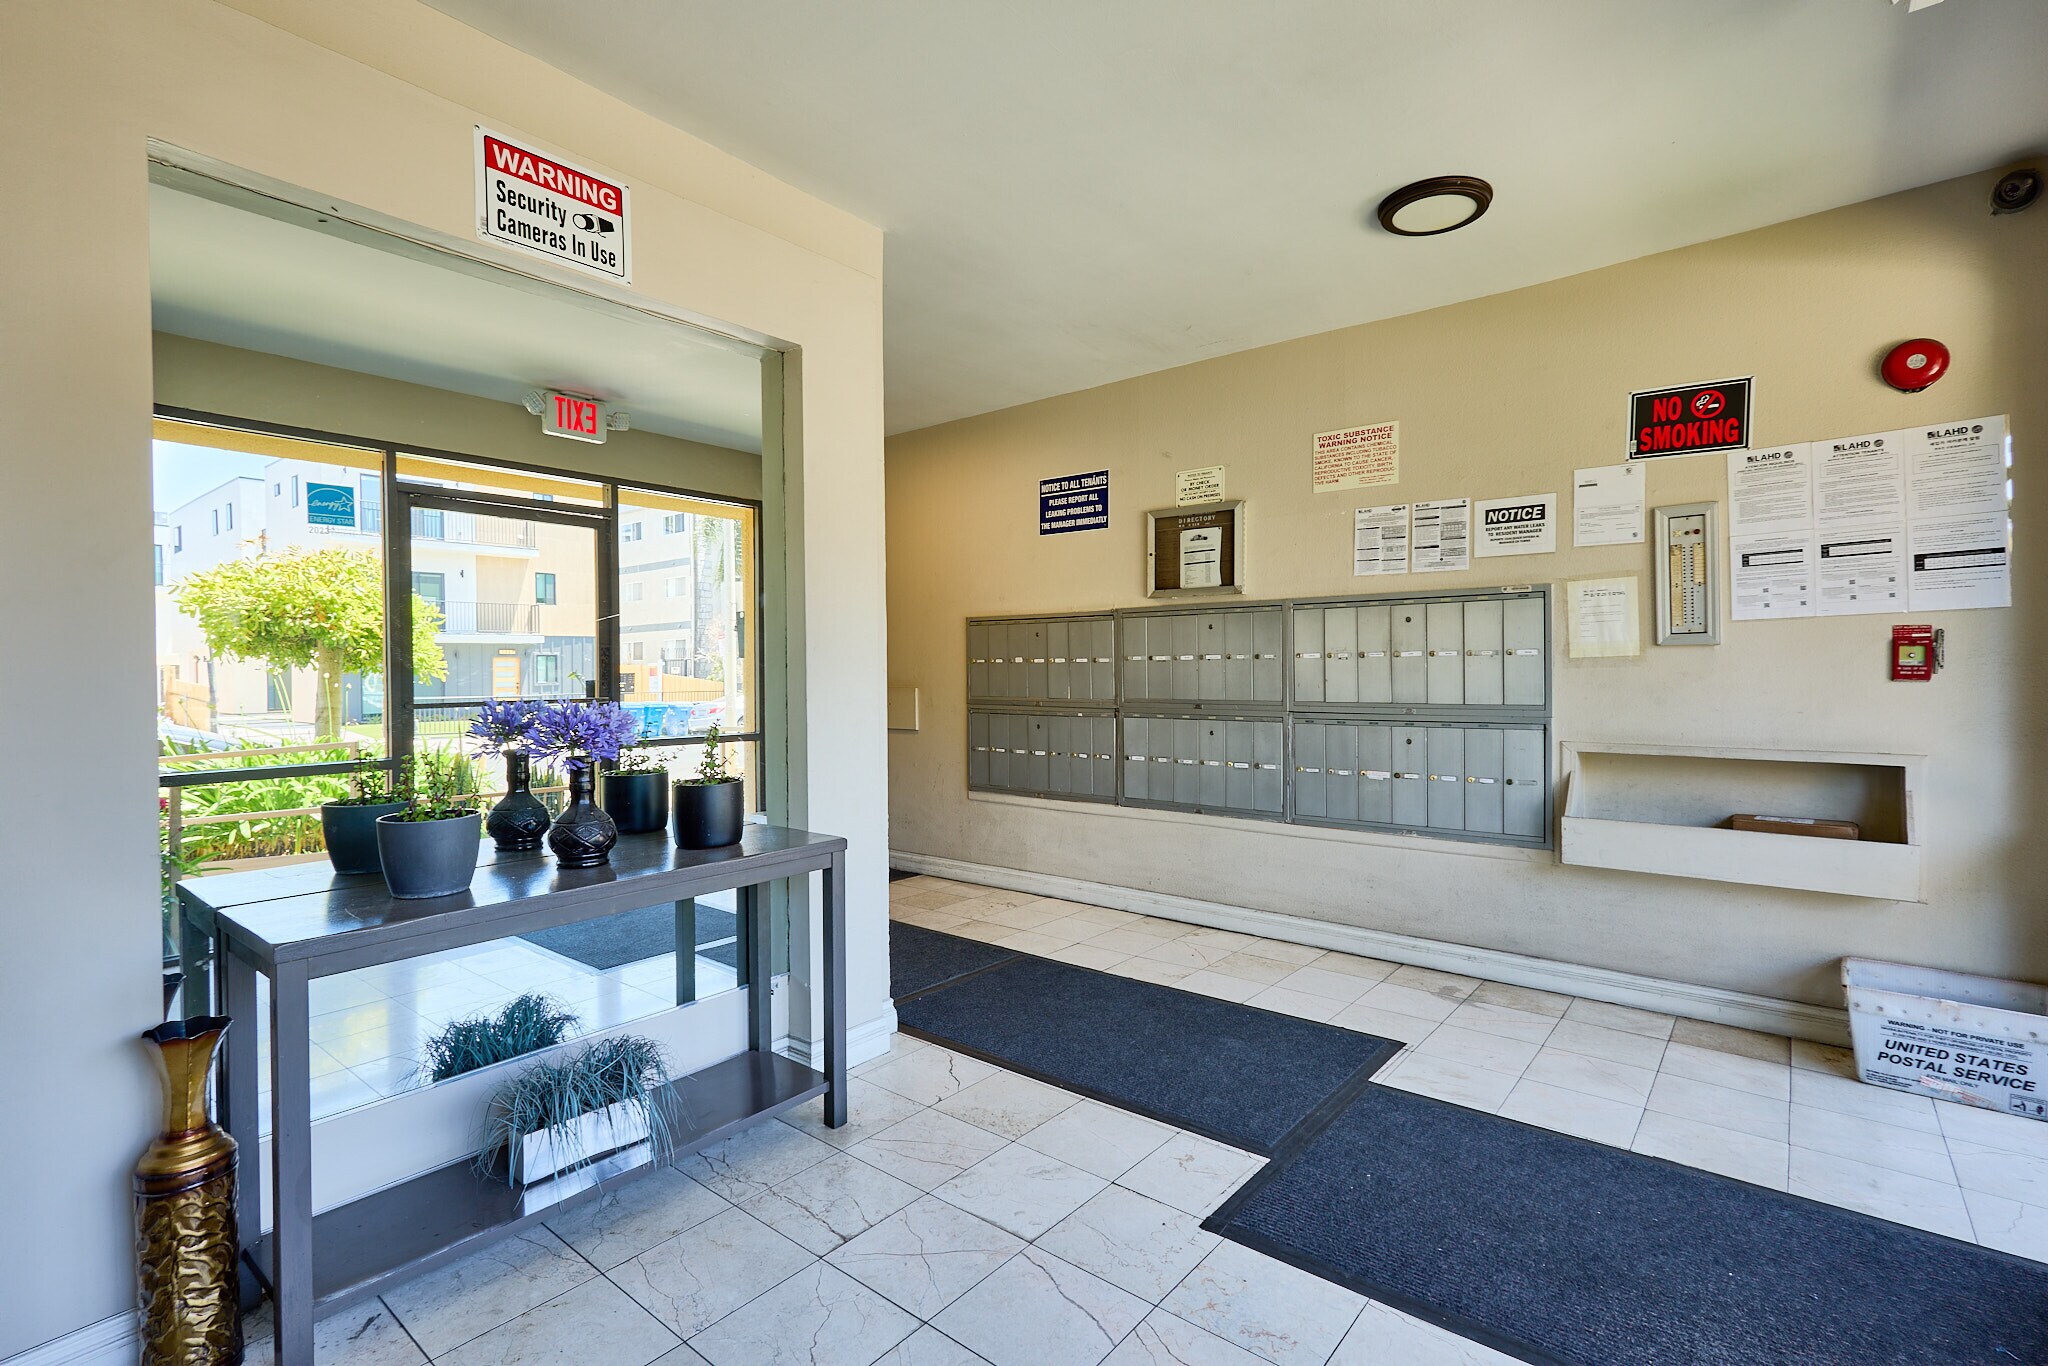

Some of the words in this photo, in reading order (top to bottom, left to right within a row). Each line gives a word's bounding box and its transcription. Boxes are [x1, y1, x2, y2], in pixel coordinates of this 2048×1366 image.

[493, 143, 617, 211] WARNING
[496, 180, 567, 228] Security
[497, 208, 567, 251] Cameras
[572, 234, 586, 257] In
[591, 241, 616, 267] Use
[1653, 396, 1683, 422] NO
[1318, 434, 1341, 442] TOXIC
[1344, 425, 1394, 438] SUBSTANCE
[1640, 418, 1739, 451] SMOKING
[1937, 427, 1968, 437] LAHD
[1319, 438, 1357, 448] WARNING
[1361, 433, 1392, 442] NOTICE
[1842, 440, 1871, 450] LAHD
[1755, 452, 1781, 461] LAHD
[1041, 483, 1060, 493] NOTICE
[1061, 481, 1068, 490] TO
[1070, 480, 1080, 489] ALL
[1049, 497, 1067, 506] PLEASE
[1068, 495, 1088, 503] REPORT
[1046, 509, 1066, 518] LEAKING
[1067, 505, 1094, 515] PROBLEMS
[1178, 515, 1216, 523] DIRECTORY
[1487, 506, 1543, 523] NOTICE
[1051, 520, 1075, 528] MANAGER
[1888, 1020, 1925, 1031] WARNING
[1970, 1035, 2004, 1045] PRIVATE
[2007, 1041, 2025, 1049] USE
[1884, 1039, 1949, 1060] UNITED
[1954, 1053, 2028, 1076] STATES
[1877, 1052, 1947, 1074] POSTAL
[1952, 1067, 2036, 1092] SERVICE
[1960, 1080, 1979, 1088] ONLY
